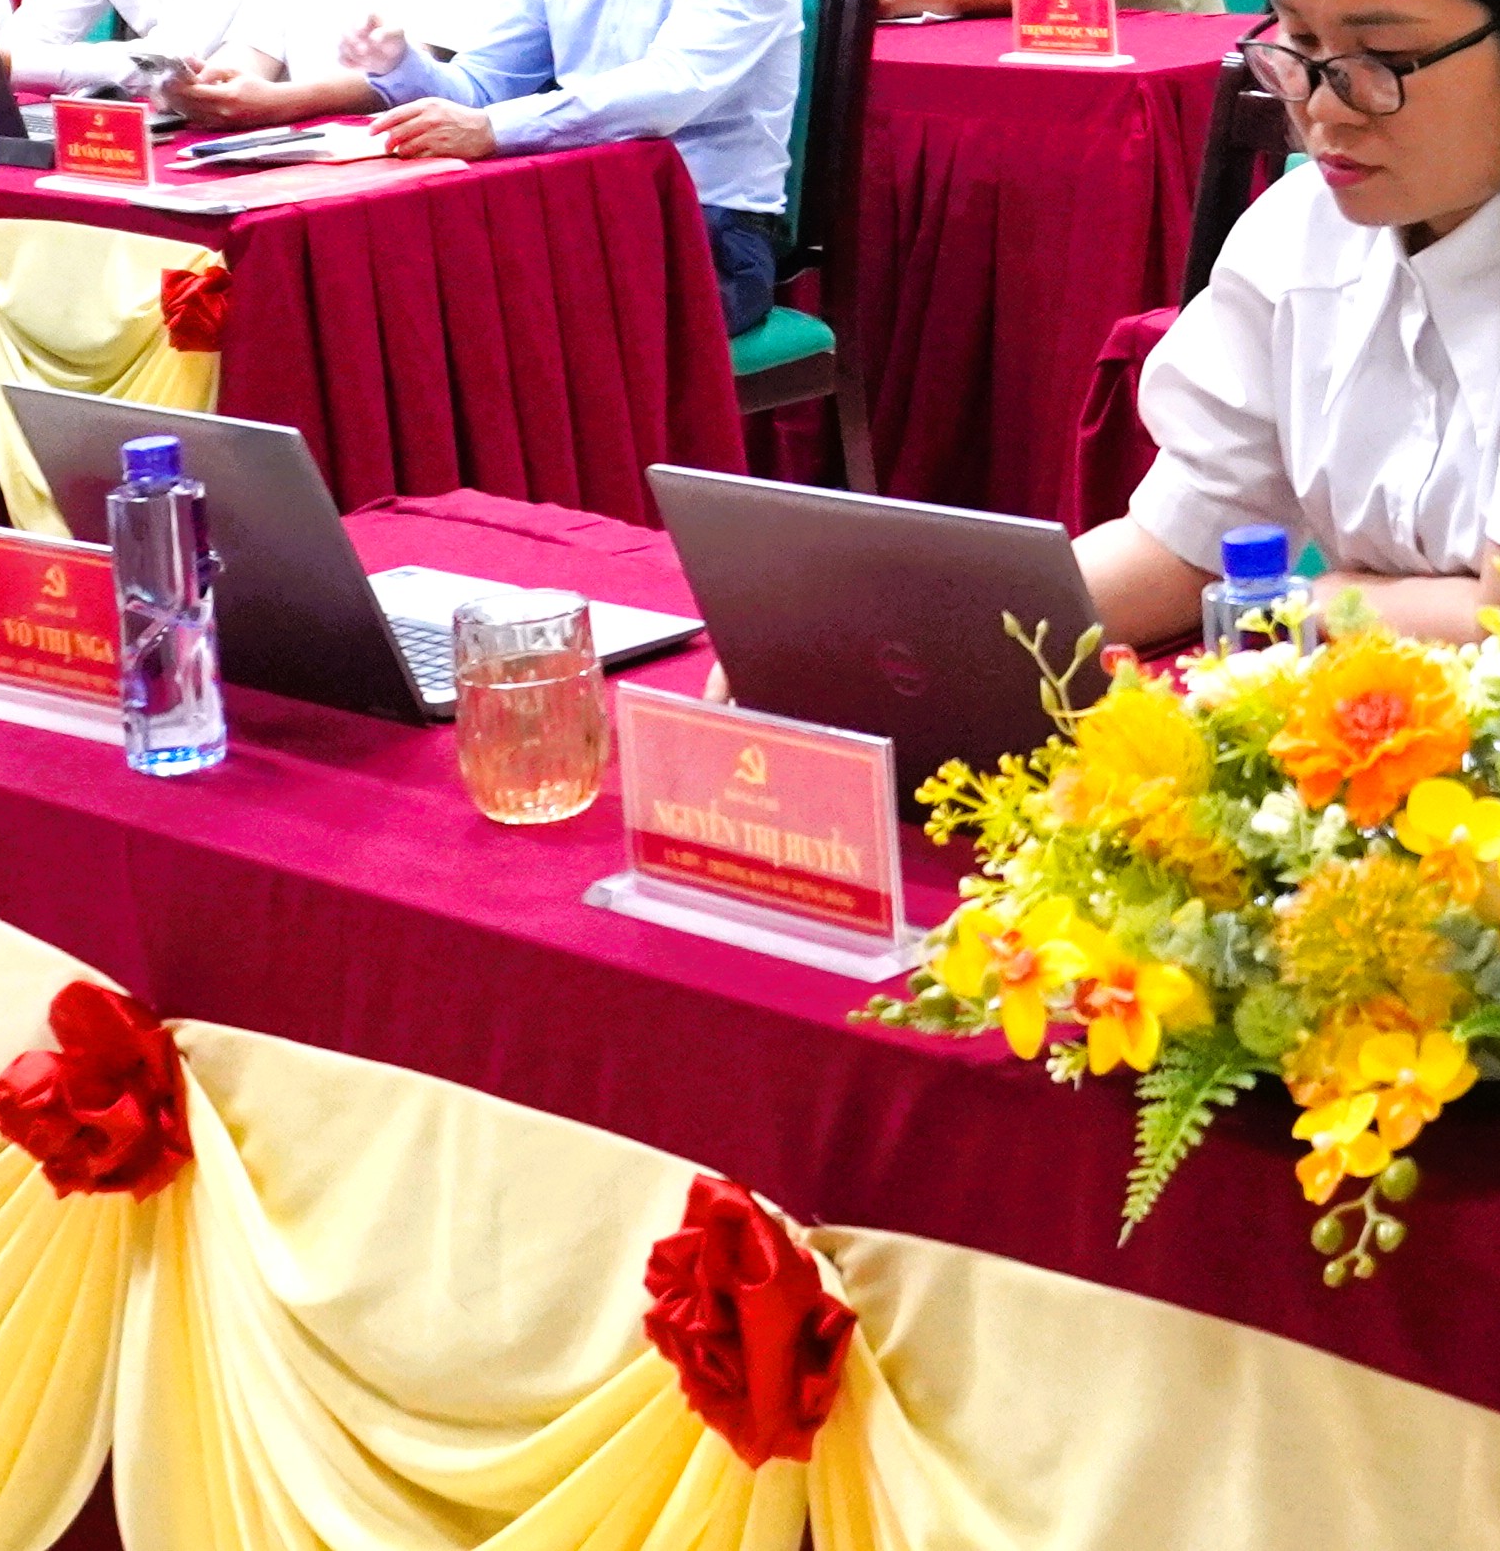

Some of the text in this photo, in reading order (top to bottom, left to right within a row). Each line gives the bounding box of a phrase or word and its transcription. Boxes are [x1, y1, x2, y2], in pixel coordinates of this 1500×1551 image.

[1085, 27, 1109, 39] NAM
[34, 625, 73, 664] THỊ
[74, 632, 117, 665] NGA
[743, 822, 781, 868] THỊ
